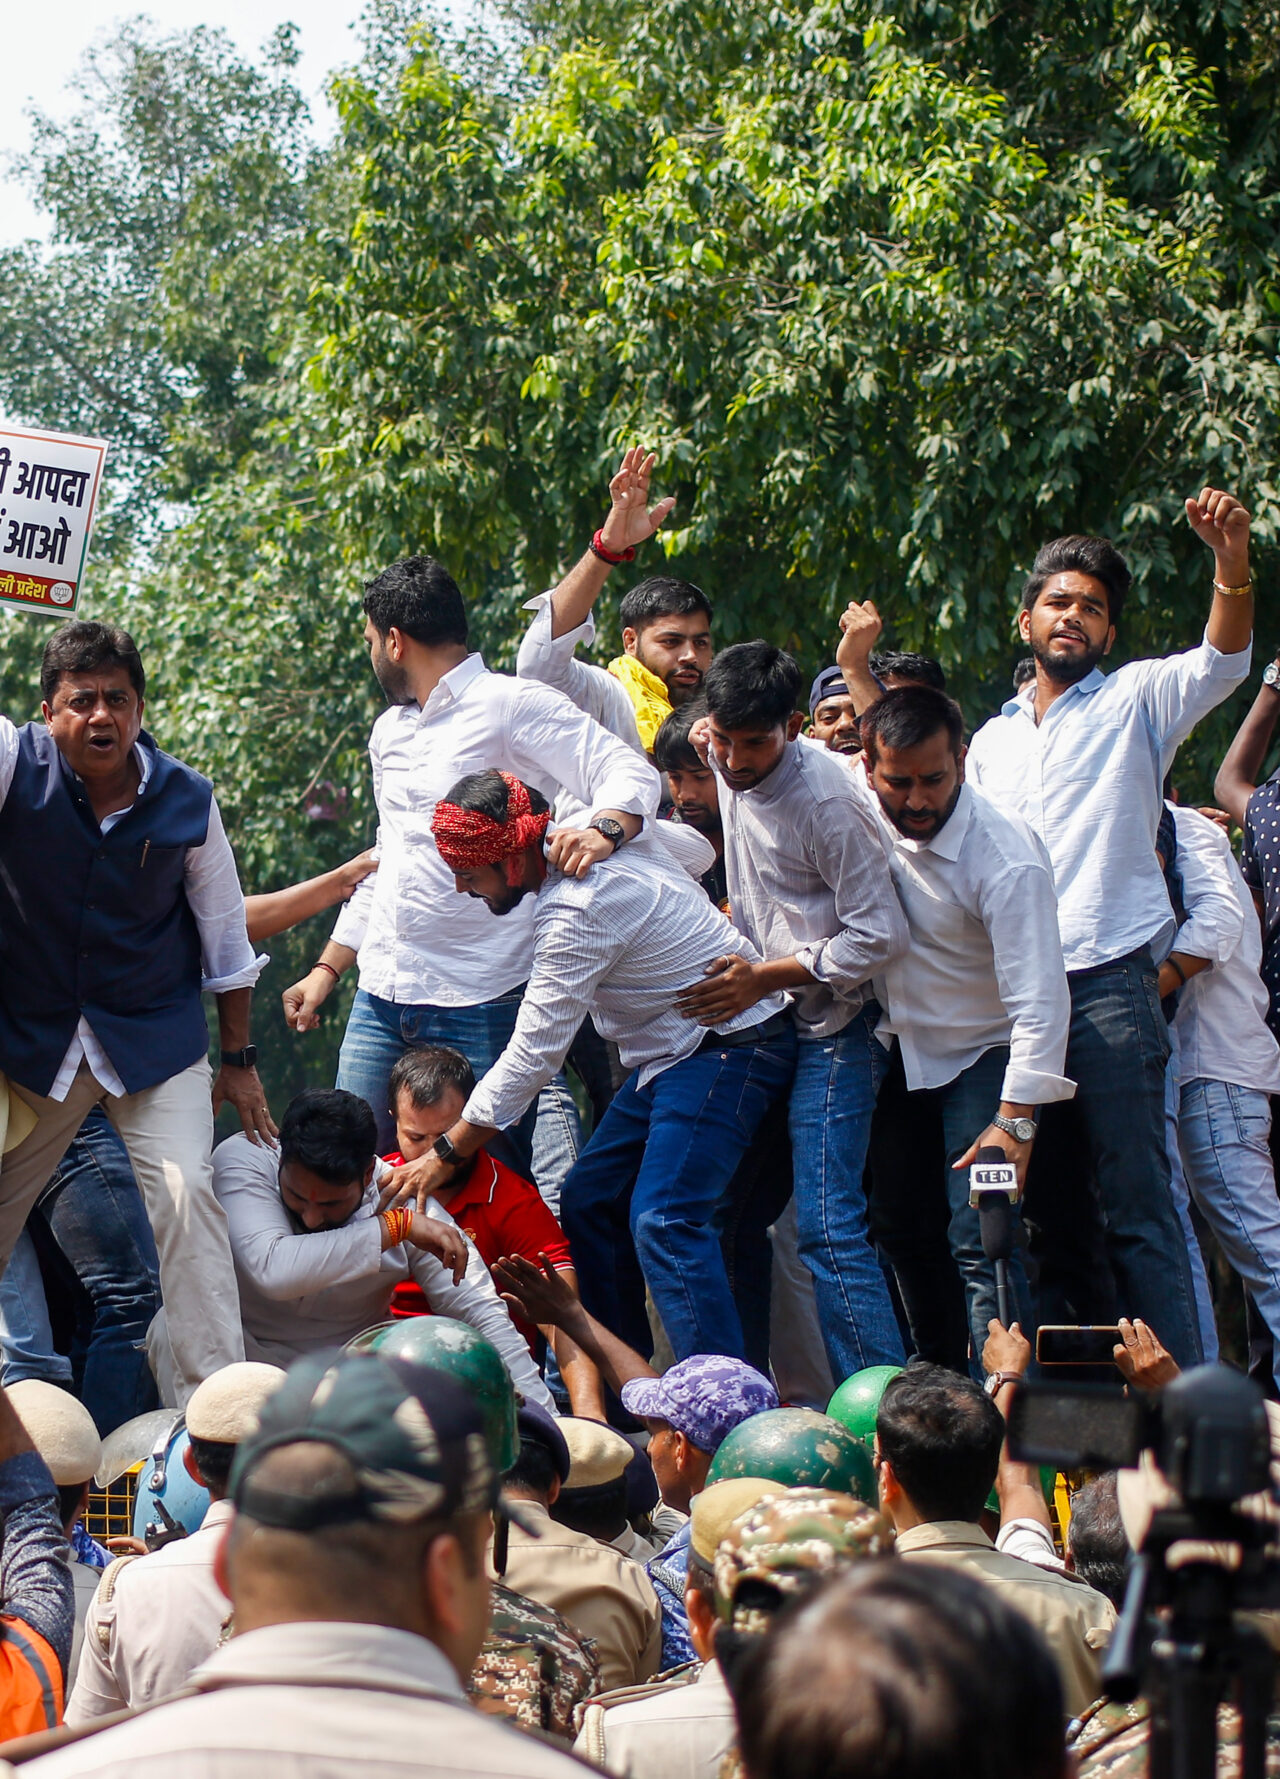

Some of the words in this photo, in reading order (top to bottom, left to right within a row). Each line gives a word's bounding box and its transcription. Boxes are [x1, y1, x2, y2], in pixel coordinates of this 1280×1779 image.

[13, 461, 91, 508] आपदा
[3, 516, 72, 566] आओ
[15, 578, 48, 599] प्रदेश
[980, 1171, 1009, 1182] TEN
